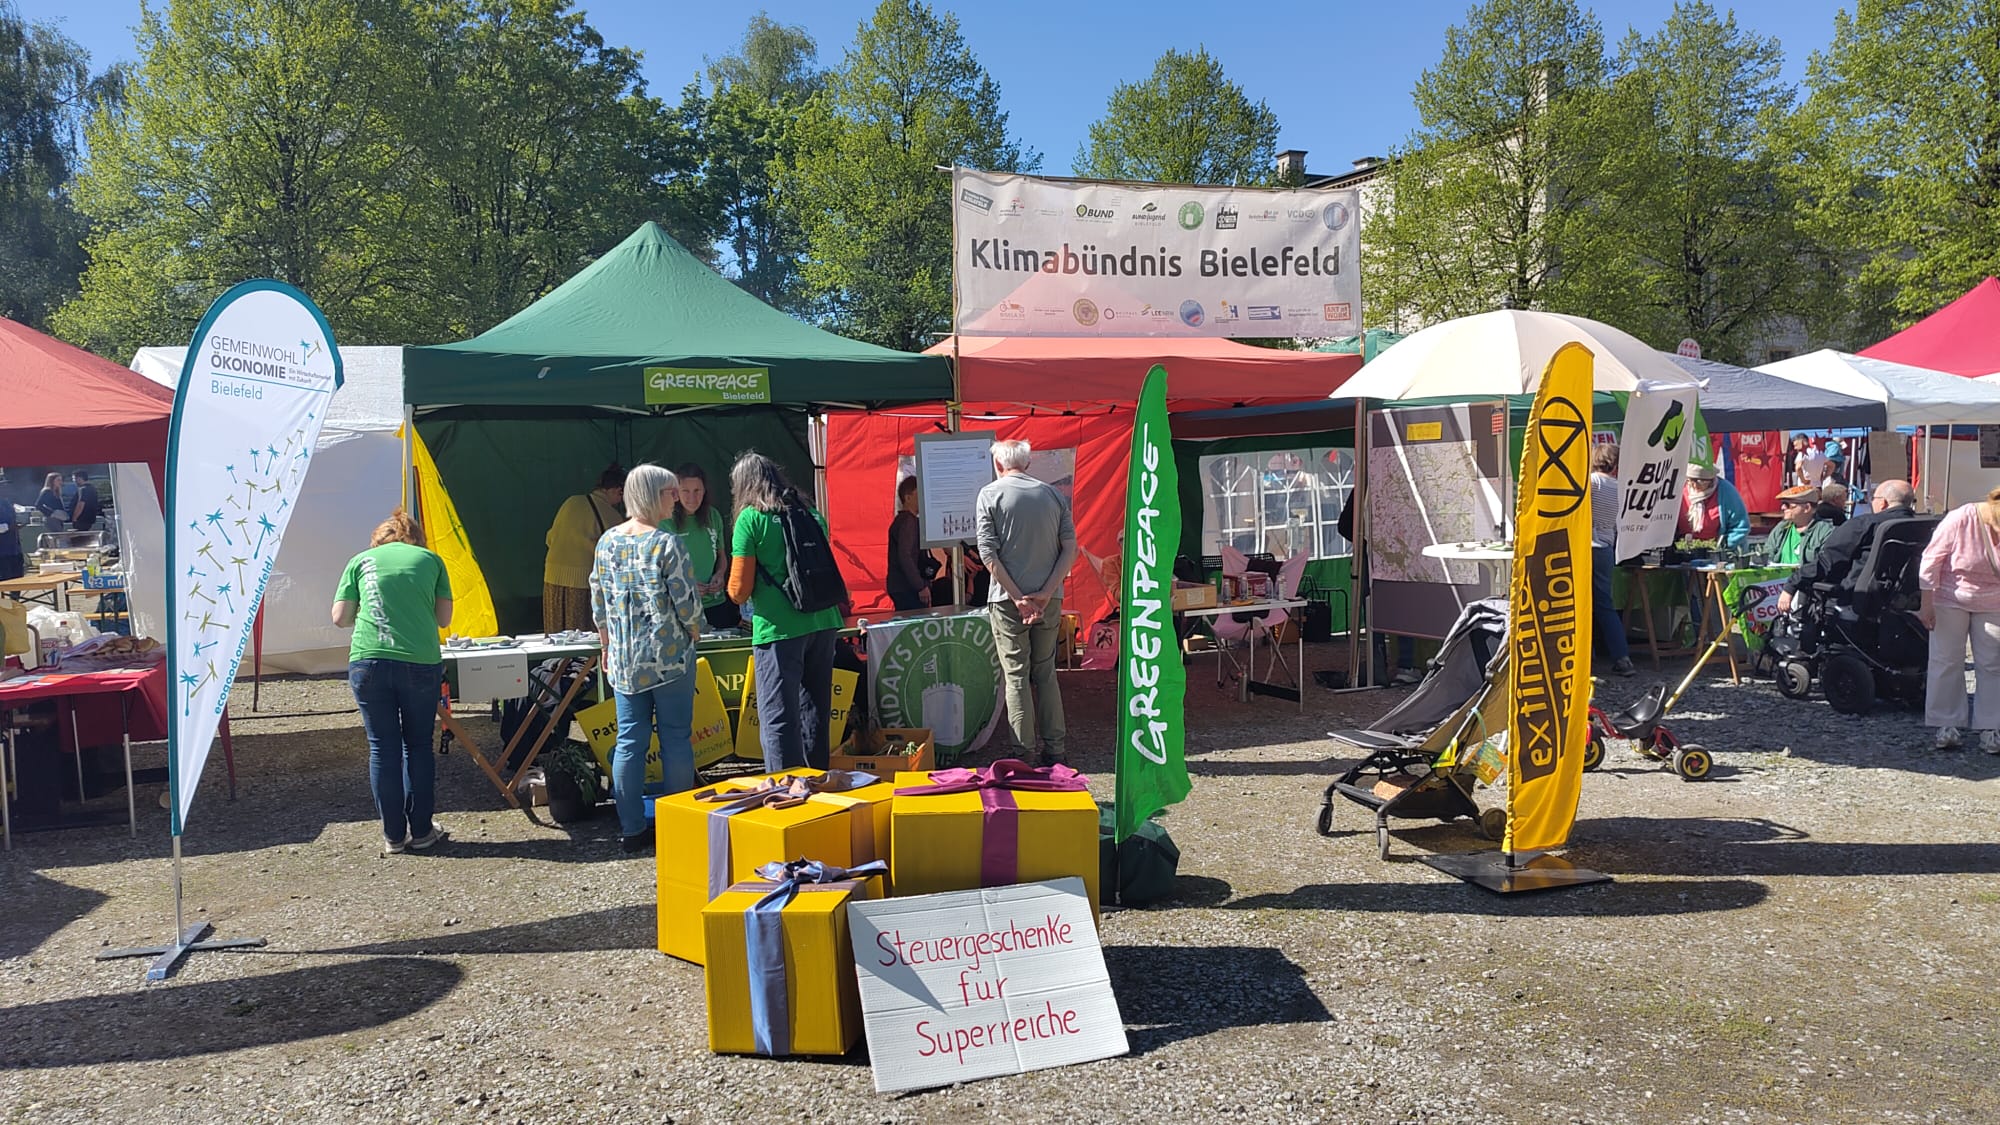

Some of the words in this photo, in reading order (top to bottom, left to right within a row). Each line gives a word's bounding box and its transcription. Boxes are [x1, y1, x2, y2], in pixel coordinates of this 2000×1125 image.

[1087, 208, 1114, 218] BUND
[971, 238, 1182, 278] Klimabündnis
[1200, 245, 1341, 278] Bielefeld
[210, 335, 299, 365] GEMEINWOHL
[210, 351, 287, 379] ÖKONOMIE
[211, 380, 263, 400] Bielefeld
[649, 372, 763, 391] GREENPEACE
[722, 391, 765, 400] Bielefeld
[1129, 422, 1168, 765] GREENPEACE
[214, 555, 275, 715] ecogood.org/de/bielefeld/
[1538, 551, 1576, 718] rebellion
[881, 644, 913, 729] RIDAYS
[911, 618, 956, 648] FOR
[876, 913, 1074, 970] Steuergeschenke
[957, 970, 1009, 1007] für
[916, 1000, 1081, 1065] Superreiche
